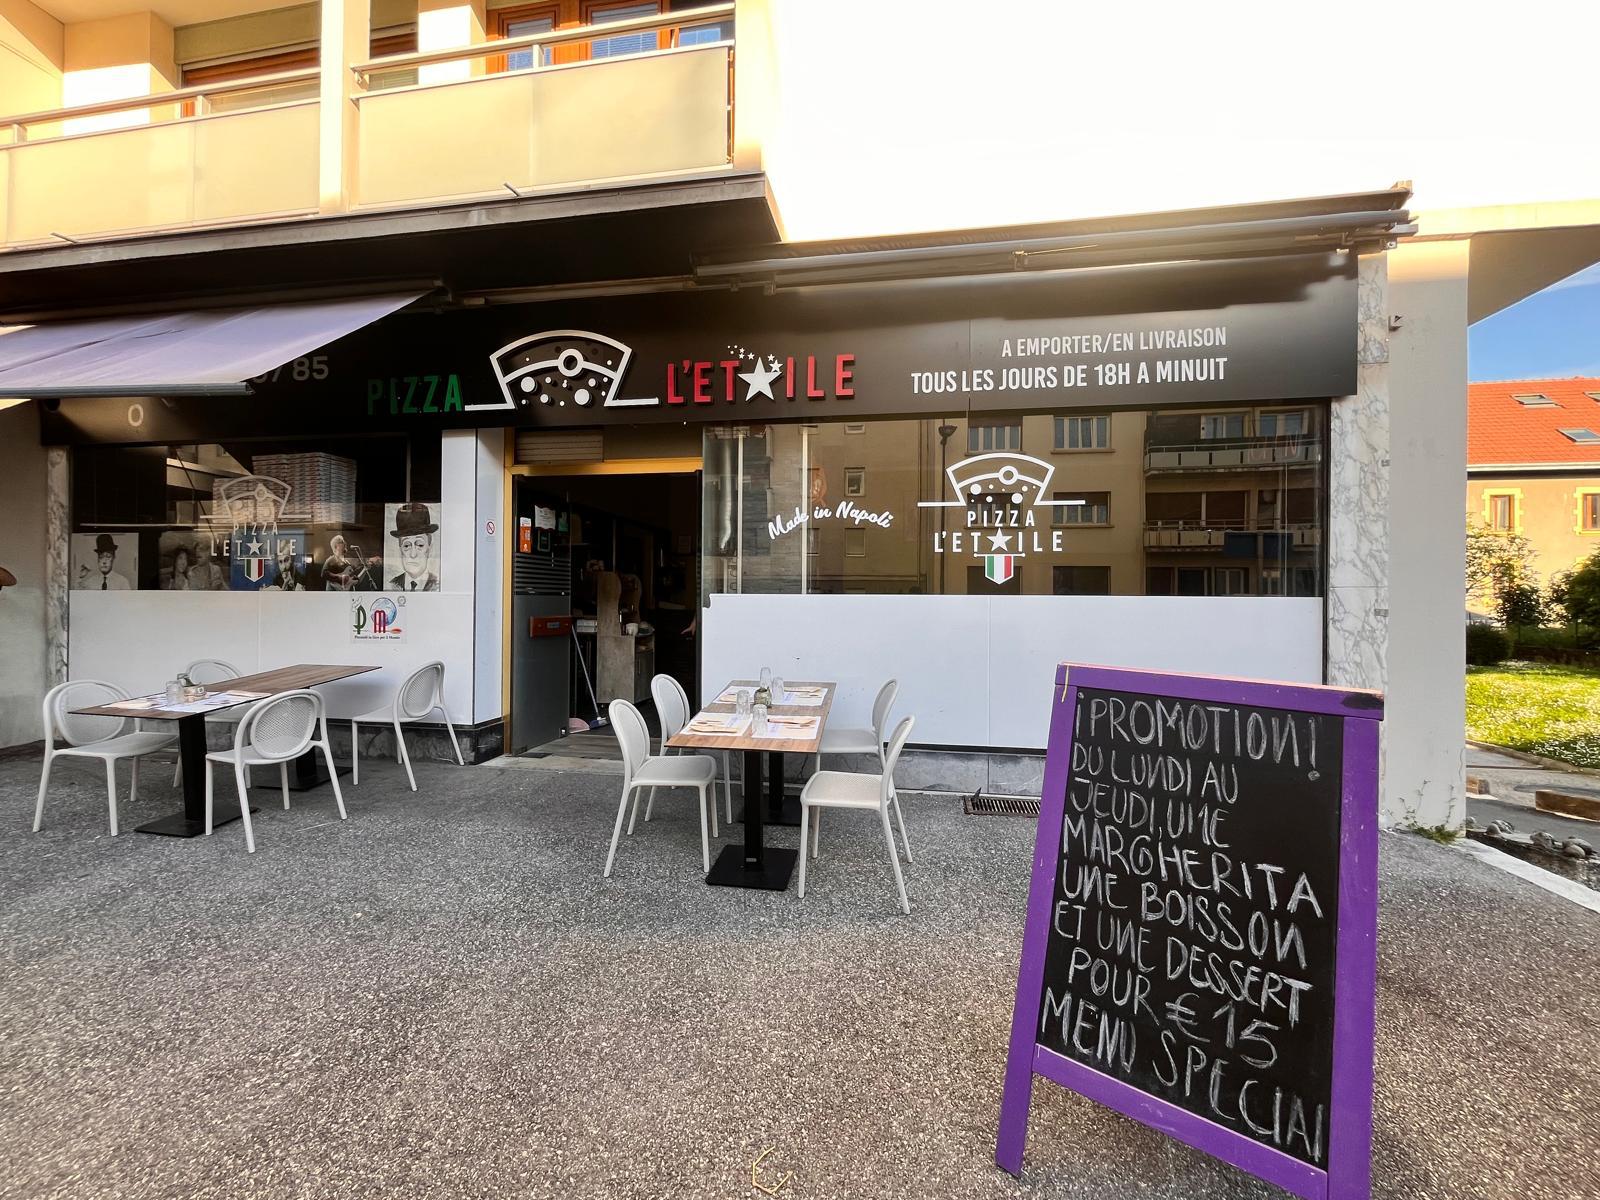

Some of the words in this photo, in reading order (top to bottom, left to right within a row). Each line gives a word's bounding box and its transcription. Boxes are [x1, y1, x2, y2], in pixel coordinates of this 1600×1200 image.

[1001, 339, 1012, 358] A
[1017, 331, 1134, 358] EMPORTER/EN
[1140, 326, 1227, 350] LIVRAISON
[292, 355, 329, 381] 85
[911, 371, 957, 394] TOUS
[961, 369, 994, 392] LES
[998, 366, 1058, 391] JOURS
[1063, 364, 1088, 387] DE
[1094, 362, 1130, 386] 18H
[1136, 361, 1150, 384] A
[1156, 357, 1228, 383] MINUIT
[367, 374, 463, 415] PIZZA
[233, 521, 279, 536] PIZZA
[768, 506, 809, 540] Made
[813, 506, 832, 519] in
[835, 500, 894, 528] Napoli
[967, 510, 1035, 528] PIZZA
[1072, 742, 1104, 776] DU
[1111, 749, 1192, 797] LUNDI
[1201, 761, 1238, 804] AU
[1167, 799, 1231, 848] UNE
[1063, 814, 1323, 919] MARGHERITA
[1063, 858, 1128, 909] UNE
[1141, 881, 1307, 969] BOISSON
[1054, 900, 1087, 941] ET
[1097, 910, 1156, 972] UNE
[1167, 936, 1314, 1031] DESSERT
[1068, 946, 1160, 1026] POUR
[1042, 986, 1136, 1073] MENU
